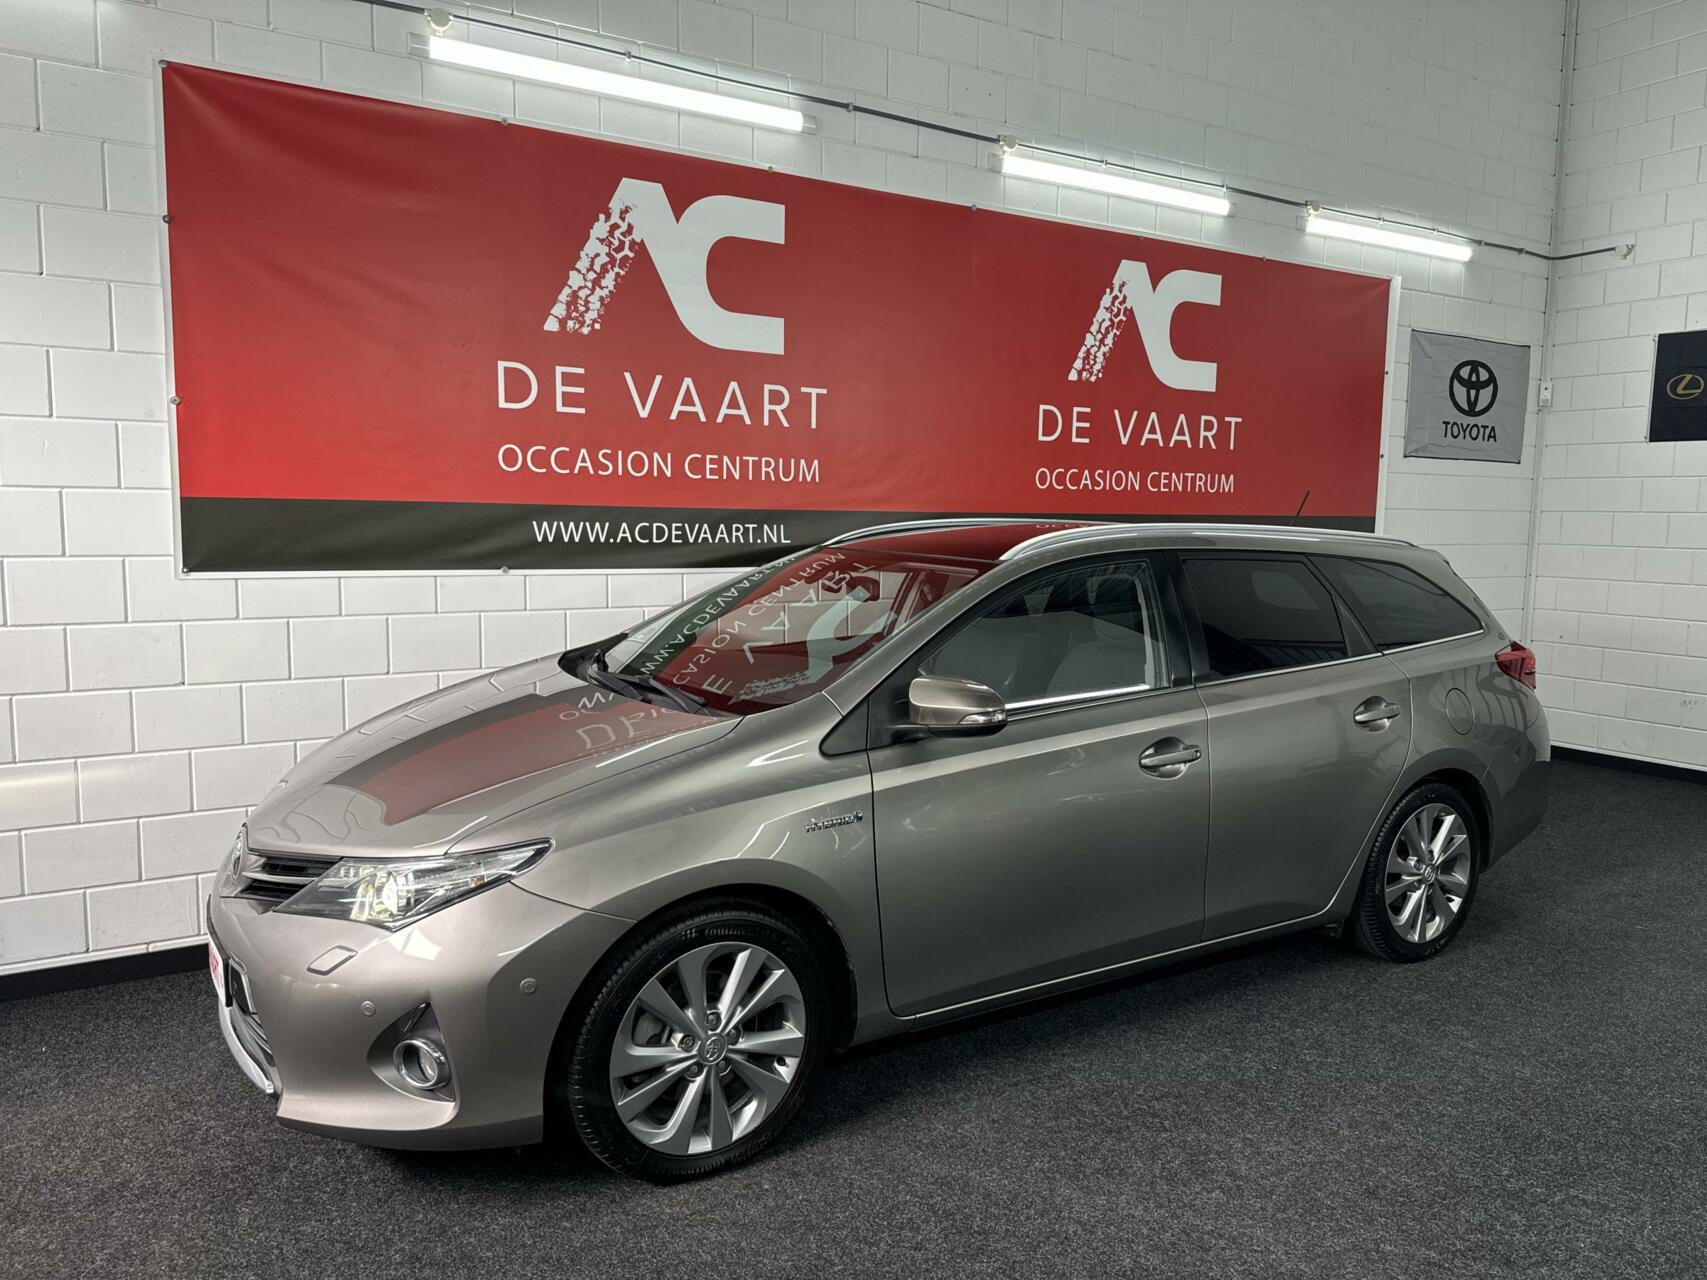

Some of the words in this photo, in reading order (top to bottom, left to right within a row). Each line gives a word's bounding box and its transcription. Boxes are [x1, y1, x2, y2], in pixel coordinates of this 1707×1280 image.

[543, 177, 785, 355] AC
[1067, 259, 1222, 392] AC
[497, 360, 586, 414] DE
[623, 371, 828, 429] VAART
[1037, 404, 1091, 443] DE
[1113, 409, 1242, 450] VAART
[1442, 420, 1497, 442] TOYOTA
[497, 443, 672, 478] OCCASION
[684, 453, 820, 482] CENTRUM
[1035, 467, 1140, 491] OCCASION
[1147, 471, 1234, 493] CENTRUM
[532, 520, 791, 544] WWW.ACDEVAART.NL
